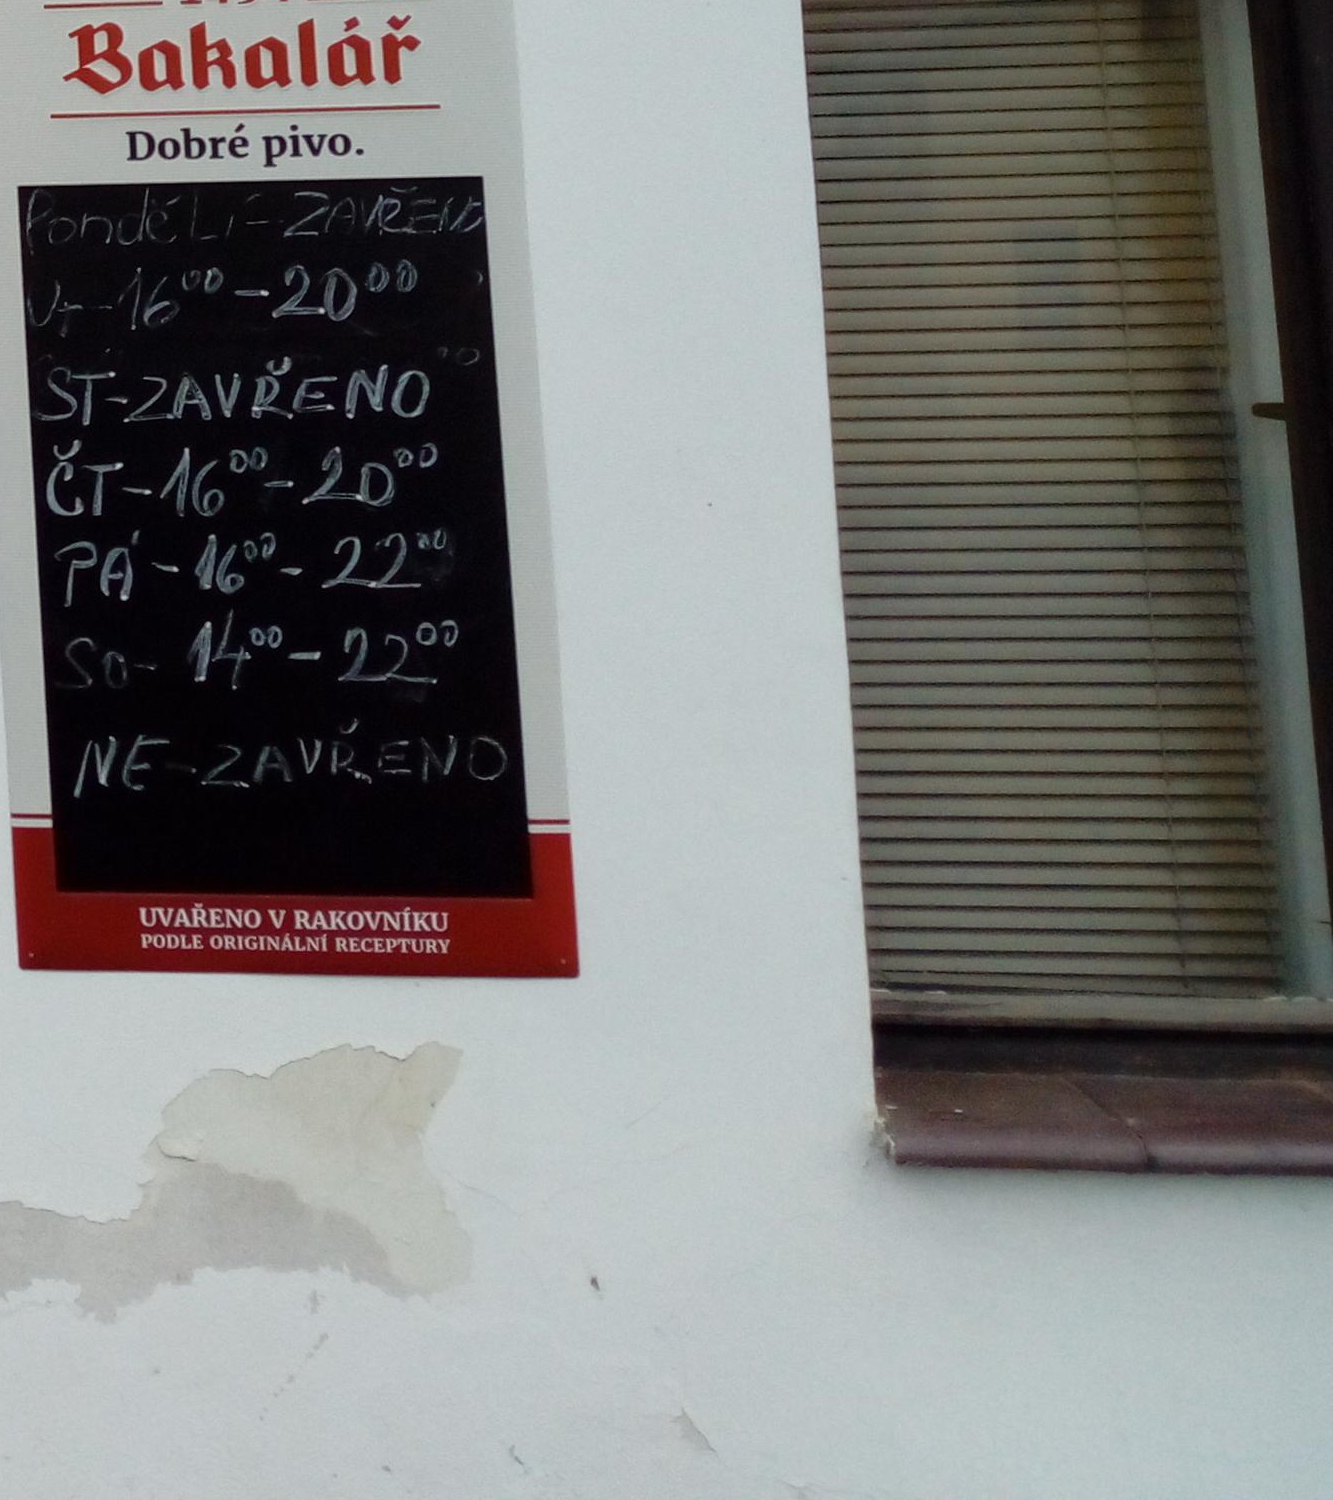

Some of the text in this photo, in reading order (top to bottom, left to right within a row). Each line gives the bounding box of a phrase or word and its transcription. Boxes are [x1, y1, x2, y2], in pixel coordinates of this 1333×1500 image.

[62, 15, 422, 95] Bakalář
[127, 124, 365, 167] Dobré pivo.
[139, 903, 449, 933] UVAŘENO V RAKOVNÍKU
[141, 933, 450, 954] PODLE ORIGINÁLNÍ RECEPTURY
